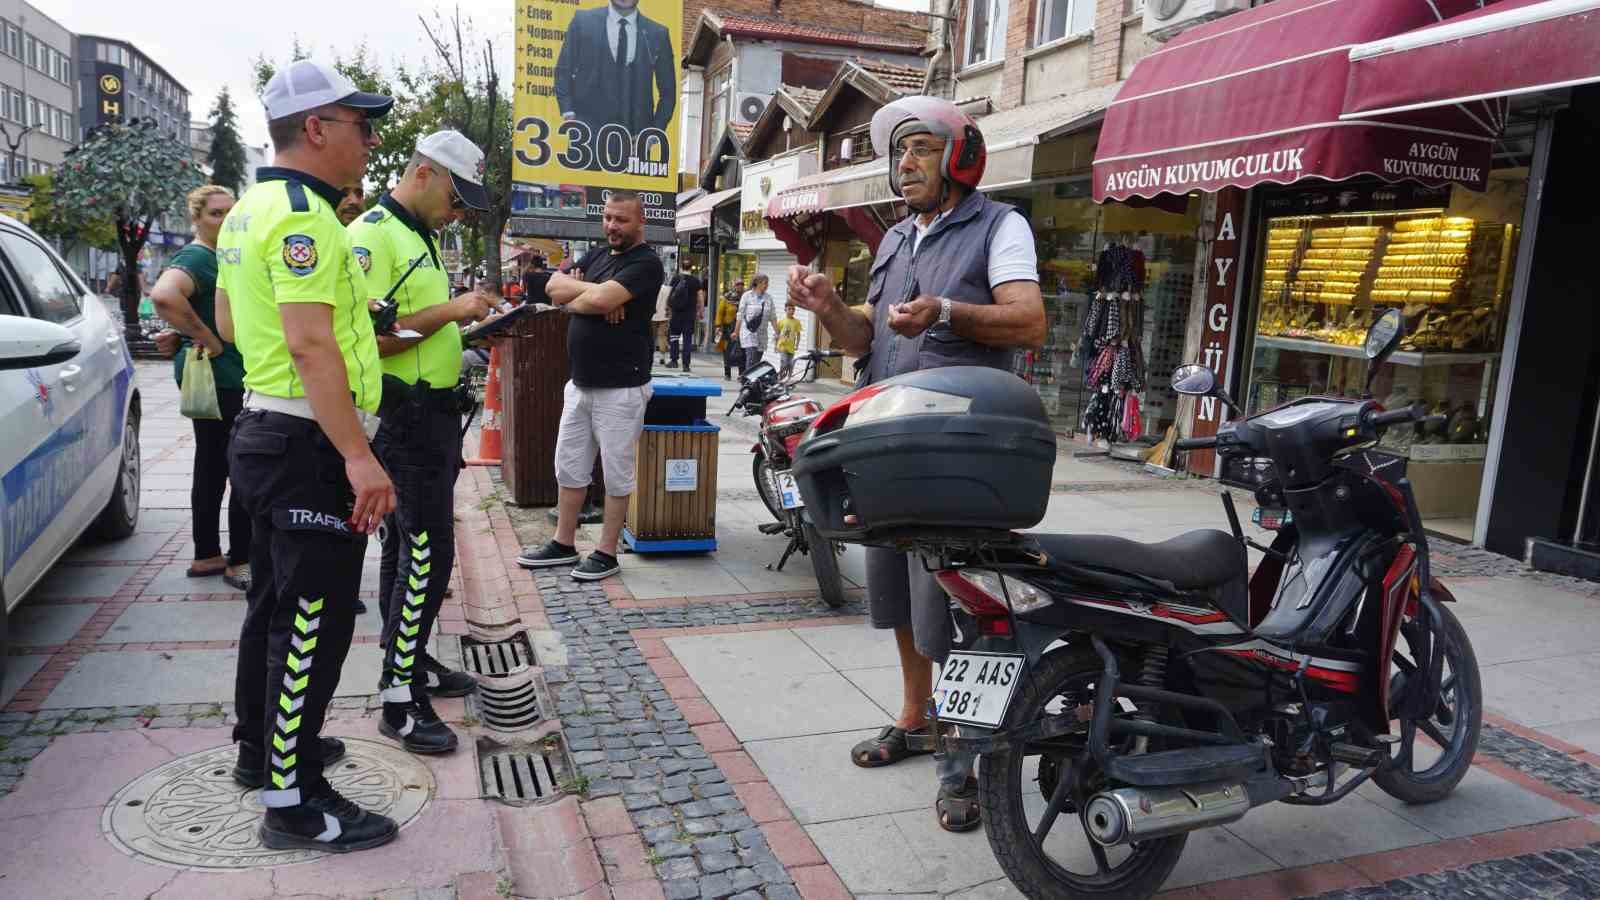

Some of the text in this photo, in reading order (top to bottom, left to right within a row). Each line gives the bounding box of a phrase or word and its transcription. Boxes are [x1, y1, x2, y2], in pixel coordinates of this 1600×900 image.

[527, 43, 553, 59] Риза
[526, 62, 554, 78] Кола
[514, 116, 670, 174] 3300
[1408, 142, 1460, 161] AYGÜN
[626, 156, 668, 176] Лири
[1105, 148, 1305, 191] AYGÜN KUYUMCULUK
[1383, 158, 1481, 182] KUYUMCULUK
[1199, 212, 1236, 421] AYGÜN
[944, 659, 1015, 686] 22 AAS
